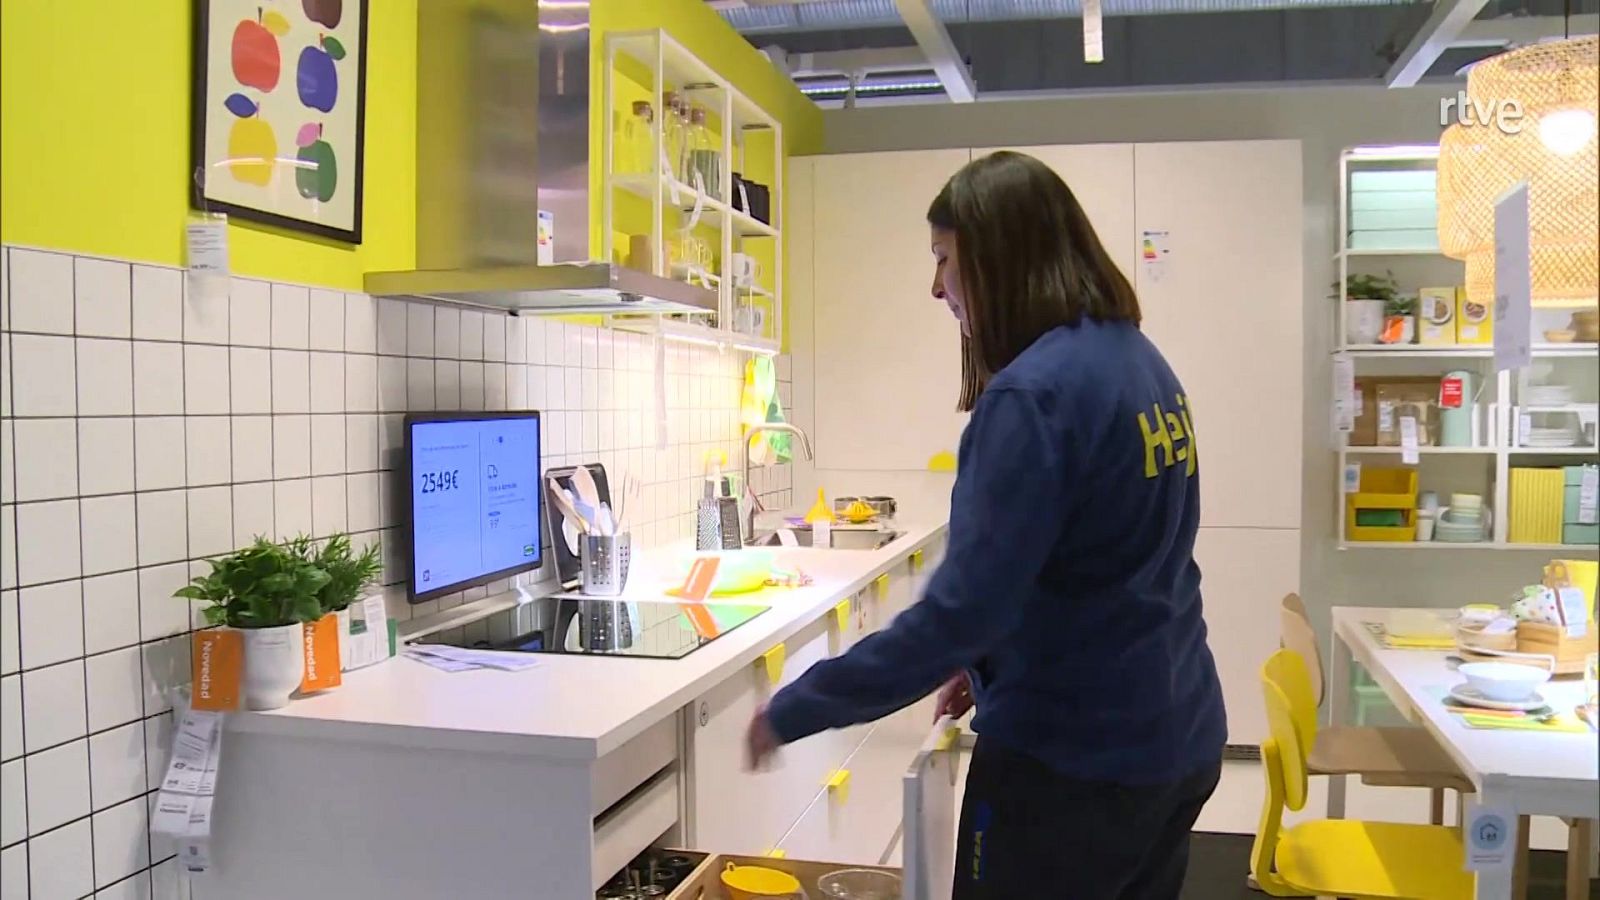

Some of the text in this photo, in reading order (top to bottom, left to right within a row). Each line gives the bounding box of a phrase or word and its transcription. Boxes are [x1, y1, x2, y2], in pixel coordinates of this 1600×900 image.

[421, 469, 459, 493] 2549€
[200, 640, 213, 699] Novedad
[304, 625, 317, 681] Novedad
